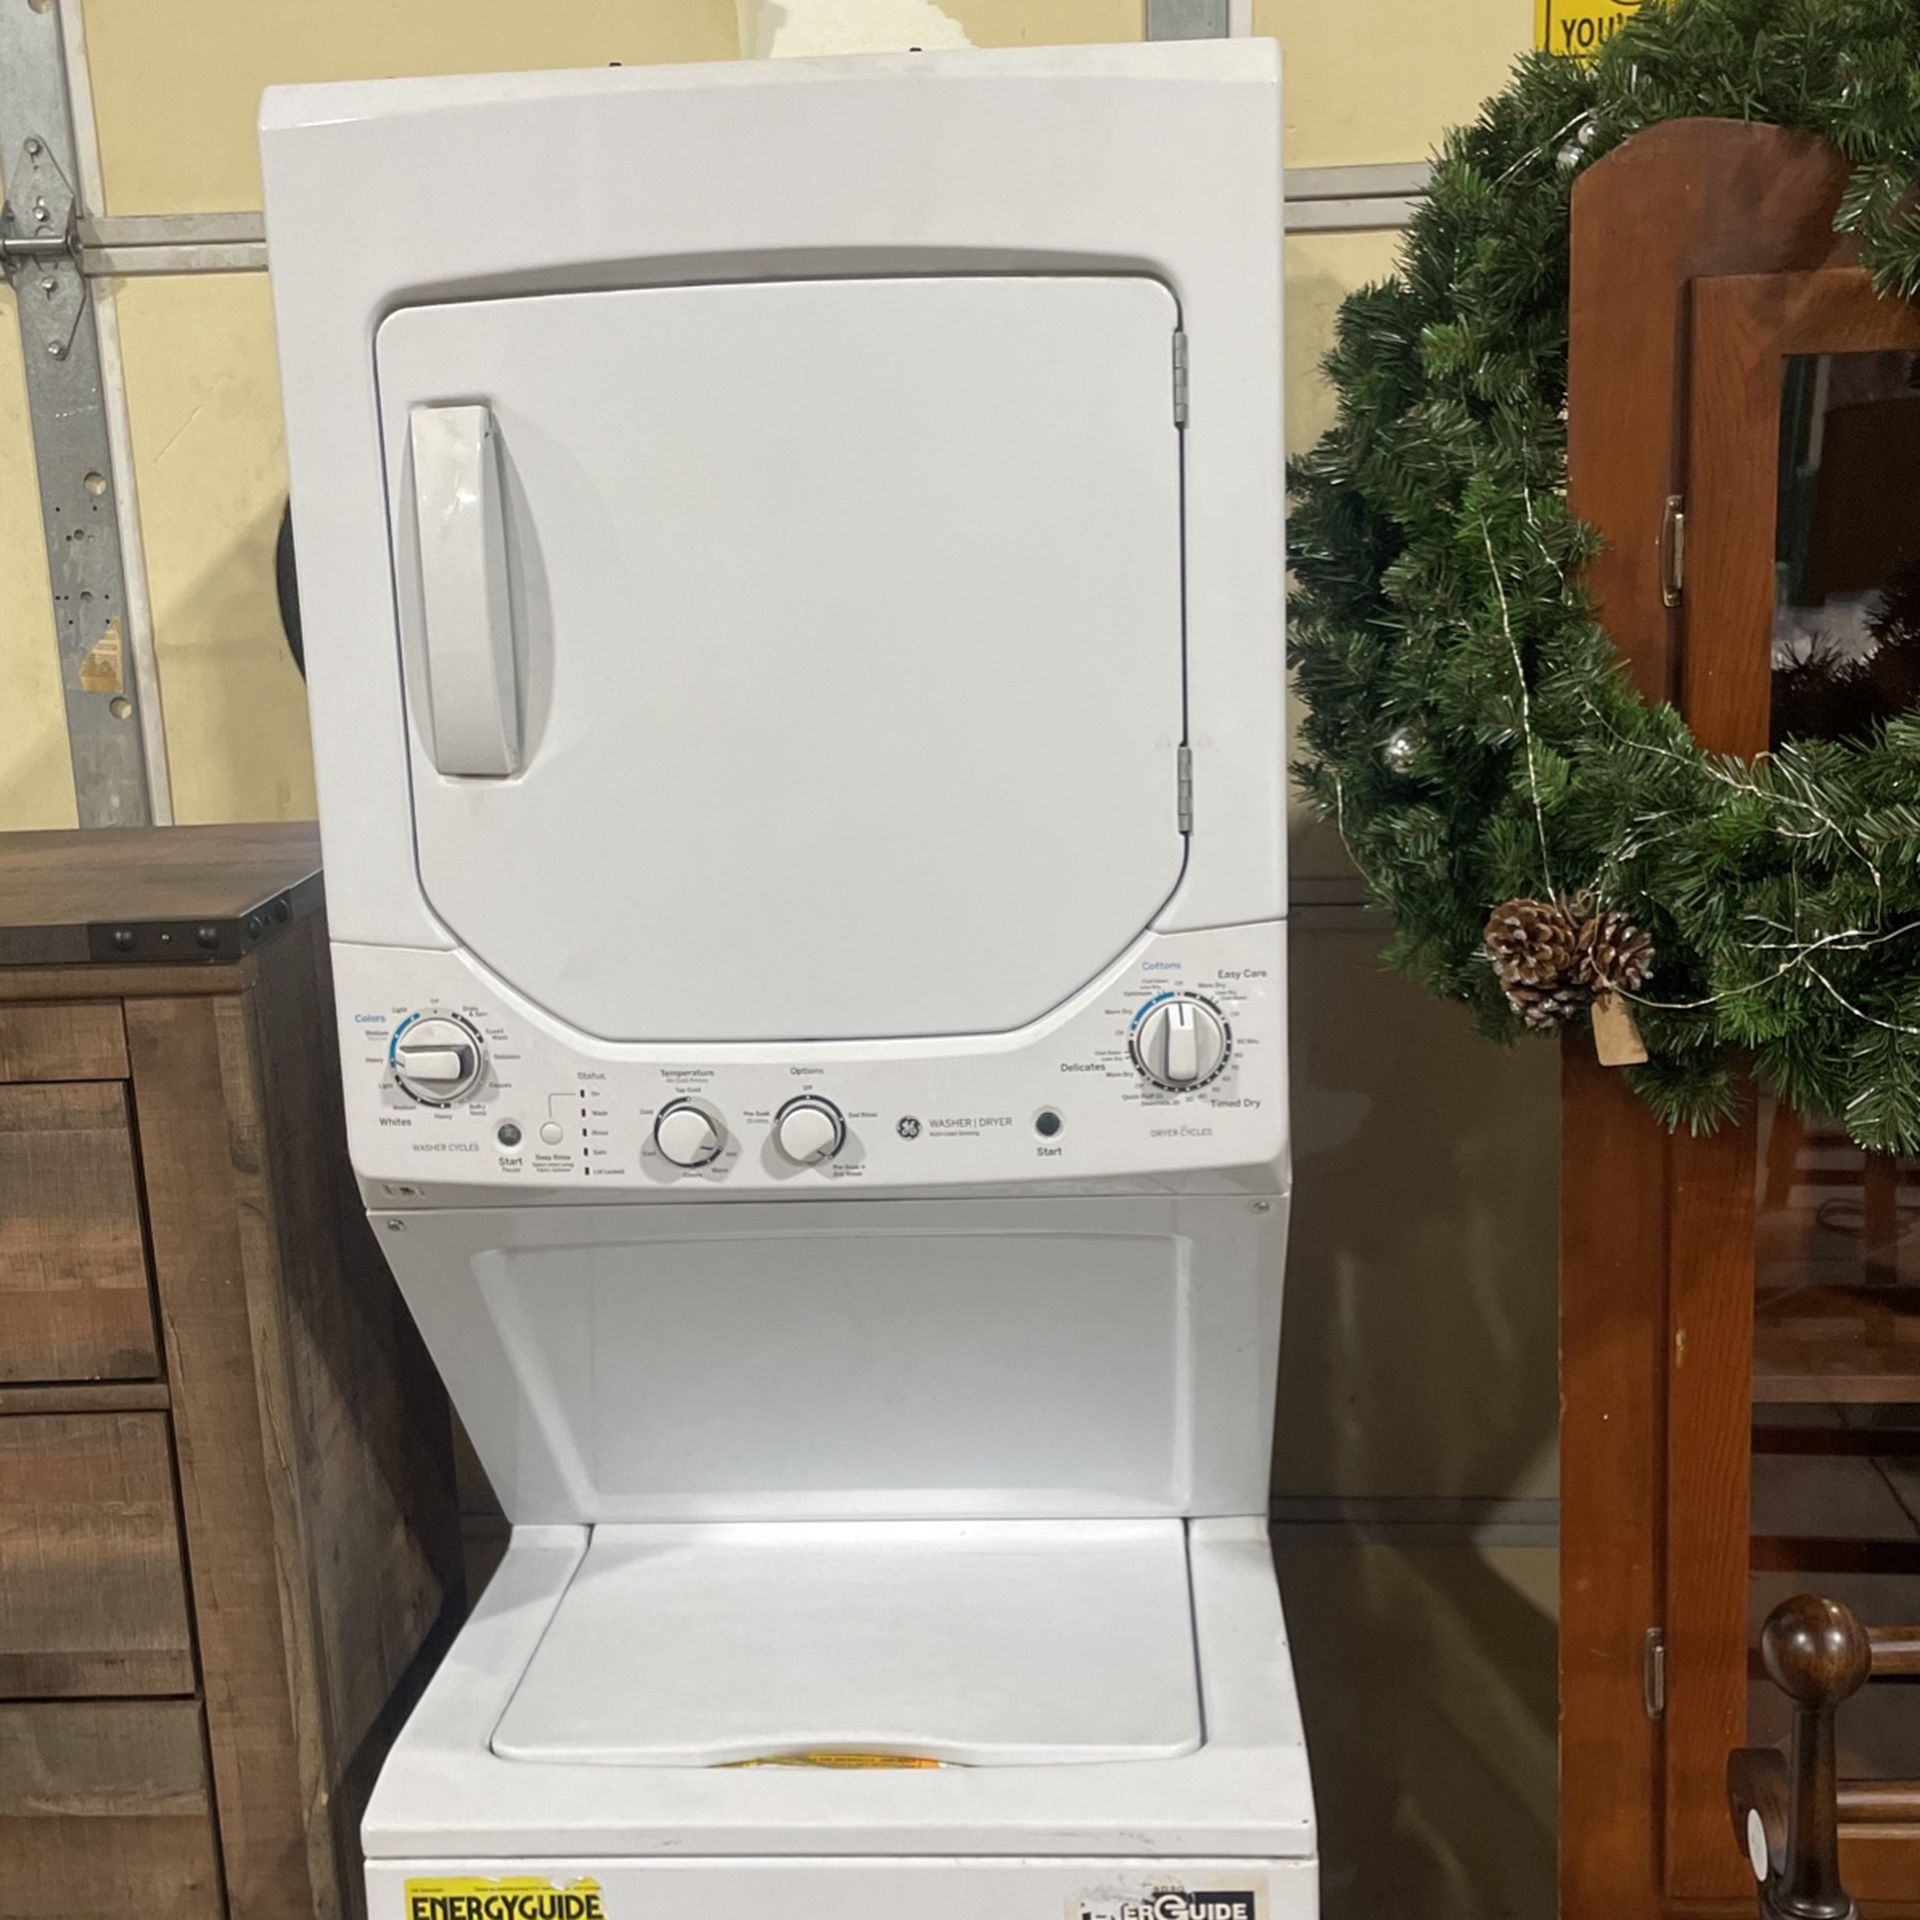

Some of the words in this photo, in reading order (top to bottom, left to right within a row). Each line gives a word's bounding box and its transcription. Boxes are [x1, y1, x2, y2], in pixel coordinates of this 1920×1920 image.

[1562, 13, 1633, 49] YOU'
[1142, 962, 1181, 970] Cottons
[1218, 970, 1240, 980] Easy
[1243, 969, 1267, 978] Care
[355, 1014, 386, 1023] Colors
[790, 1067, 824, 1075] Options
[1060, 1062, 1106, 1073] Delicates
[577, 1072, 606, 1080] Status
[660, 1069, 714, 1077] Temperature
[1211, 1100, 1241, 1108] Timed
[1244, 1099, 1261, 1109] Dry
[379, 1118, 412, 1126] Whites
[929, 1119, 972, 1128] WASHER
[979, 1117, 1012, 1127] DRYER
[1151, 1129, 1178, 1138] DRYER
[1180, 1128, 1212, 1137] CYCLES
[413, 1143, 447, 1152] WASHER
[448, 1143, 479, 1152] CYCLES
[1037, 1147, 1062, 1157] Start
[499, 1157, 523, 1166] Start
[412, 1895, 604, 1920] ENERGYGUIDE
